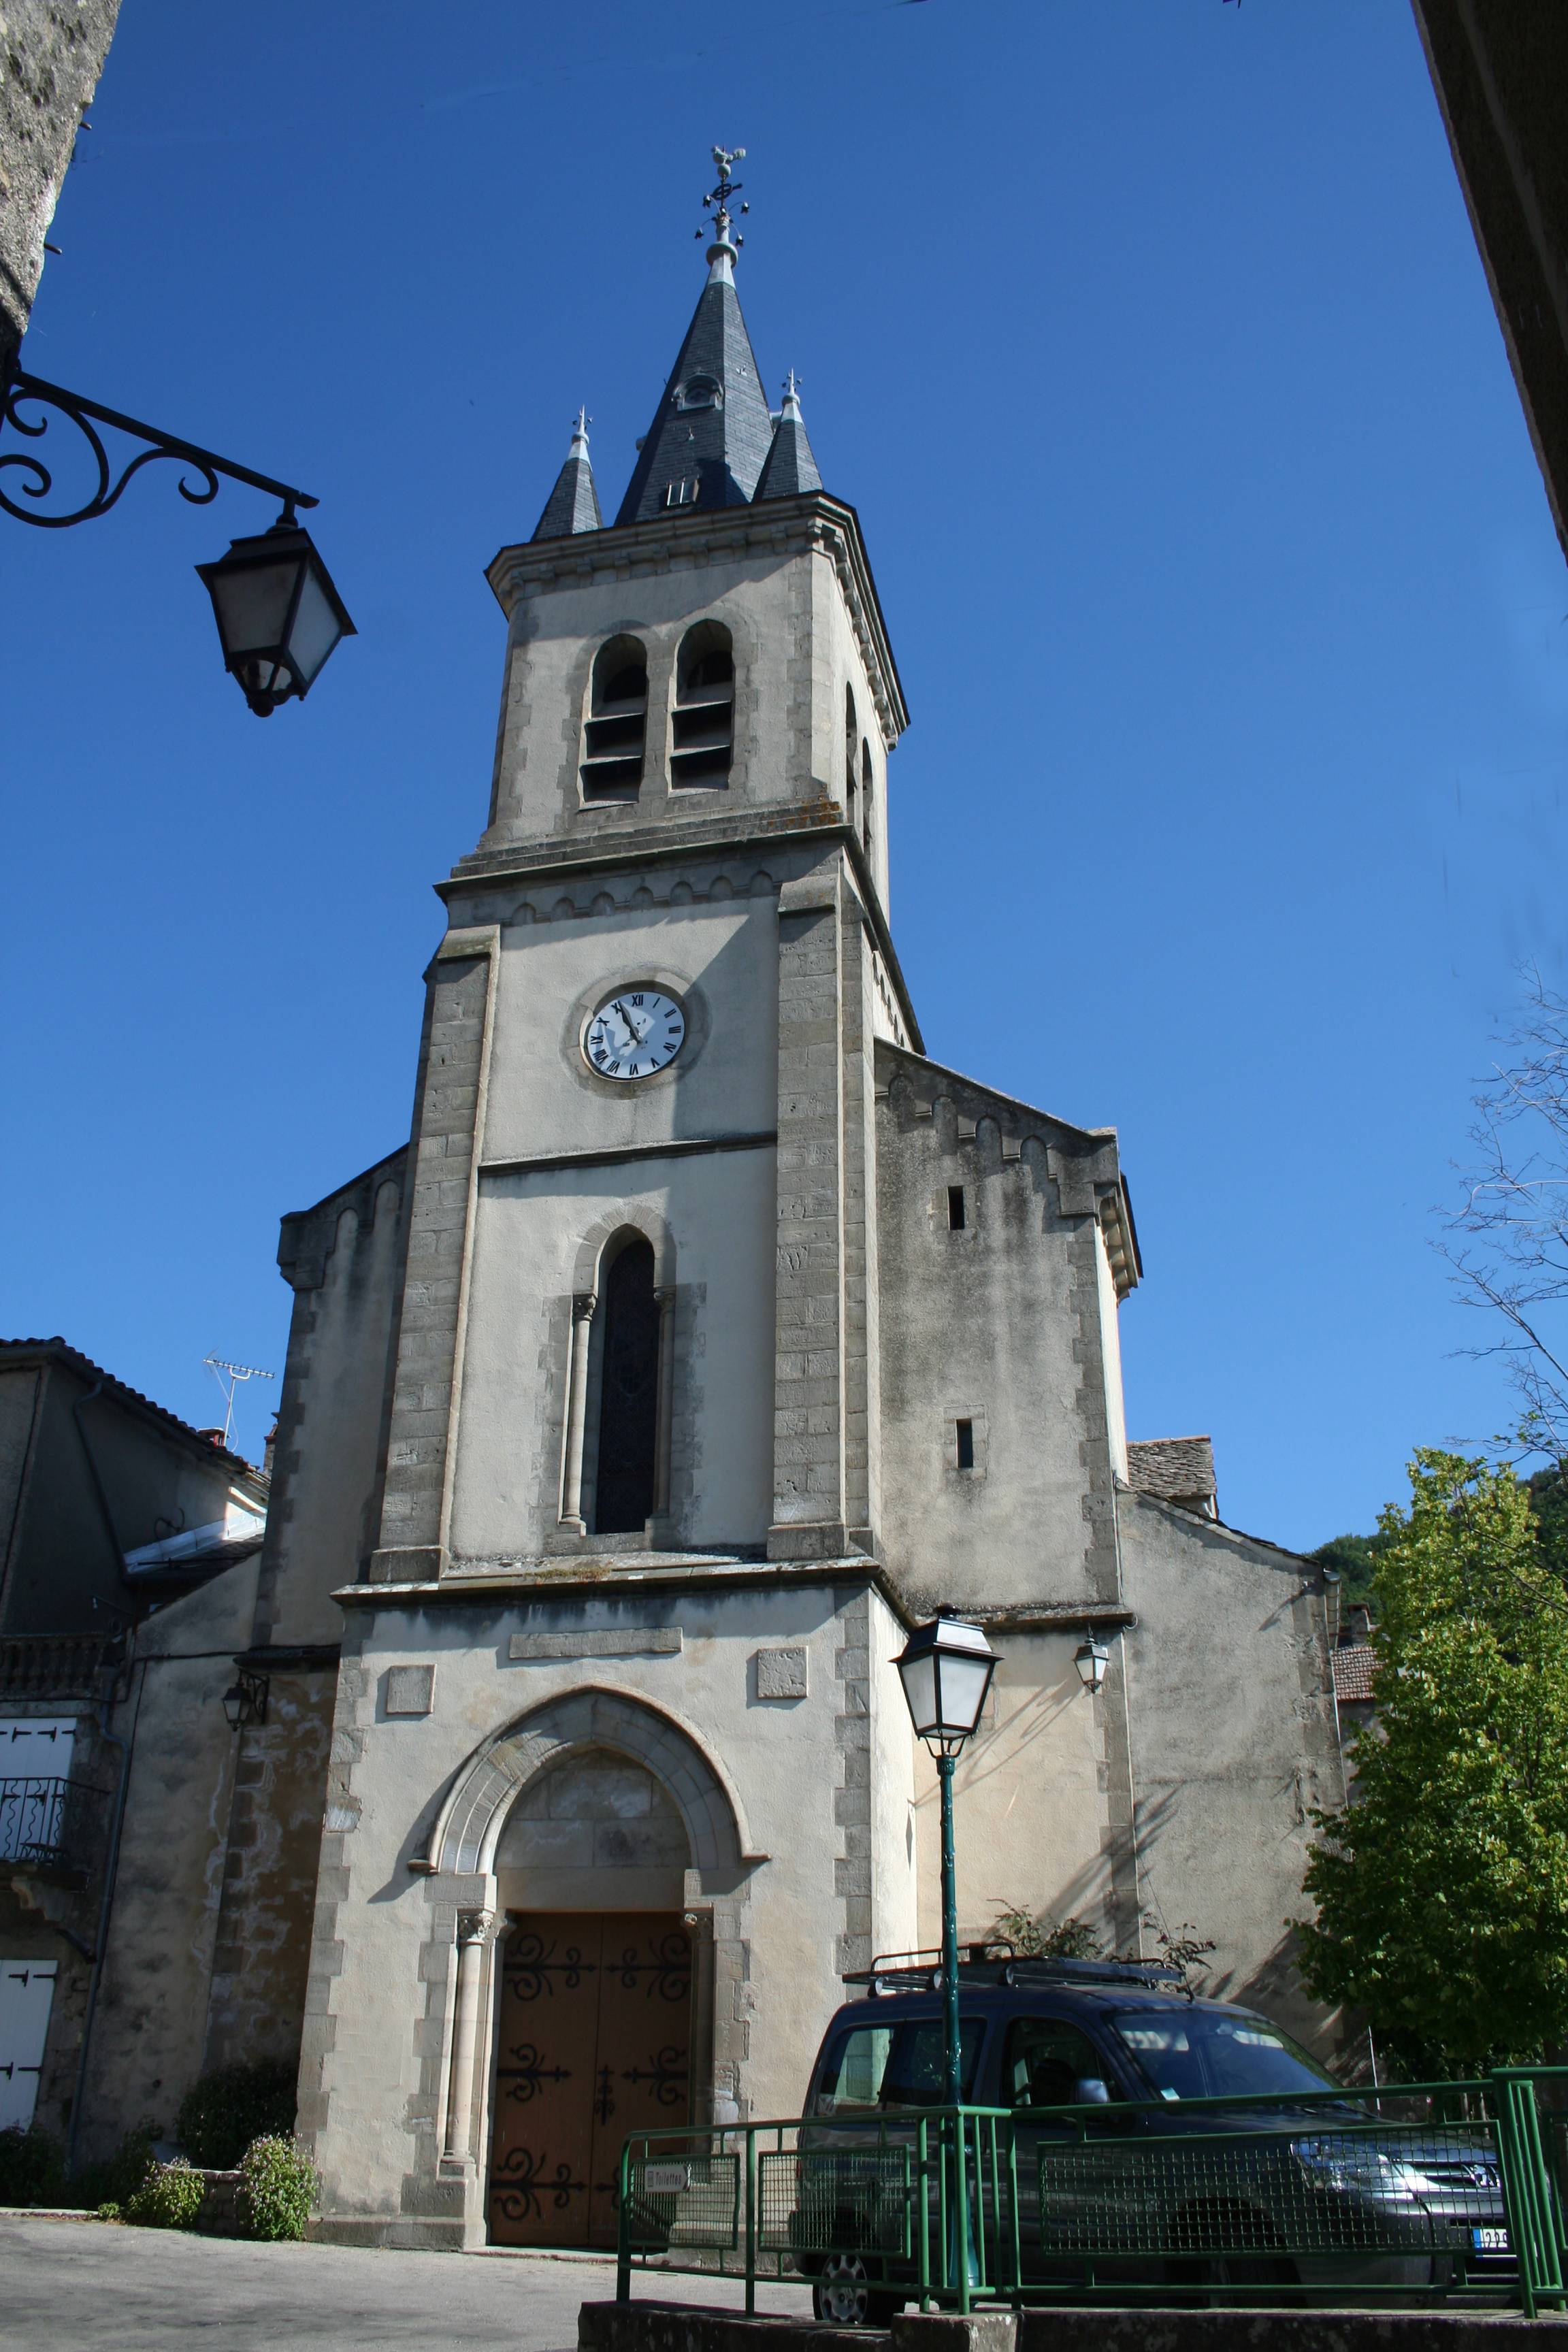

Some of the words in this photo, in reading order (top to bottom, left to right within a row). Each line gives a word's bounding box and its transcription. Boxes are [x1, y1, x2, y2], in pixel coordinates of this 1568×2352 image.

[632, 994, 644, 1007] XII
[611, 1000, 623, 1014] X
[664, 1008, 677, 1019] II
[596, 1017, 610, 1026] X
[668, 1026, 681, 1034] III
[590, 1034, 604, 1045] IX
[663, 1042, 677, 1054] IV
[593, 1049, 609, 1064] VIII
[651, 1057, 660, 1068] V
[606, 1060, 621, 1075] VII
[629, 1063, 639, 1076] VI
[656, 2172, 681, 2187] Toilettes
